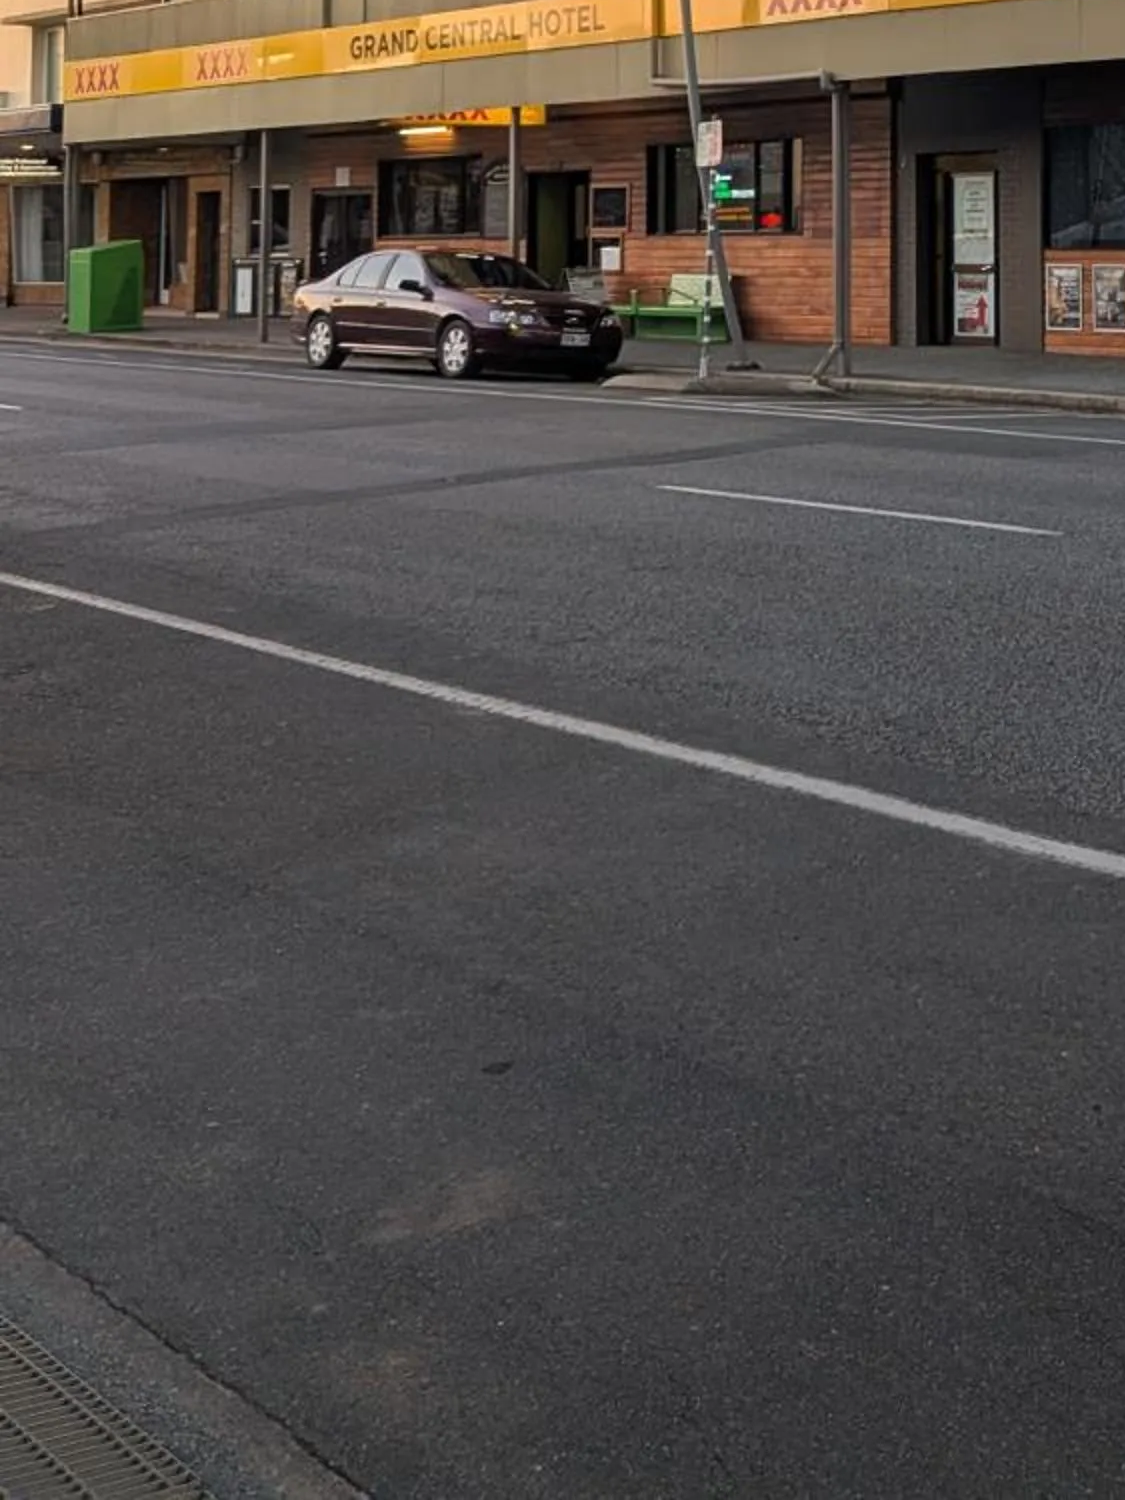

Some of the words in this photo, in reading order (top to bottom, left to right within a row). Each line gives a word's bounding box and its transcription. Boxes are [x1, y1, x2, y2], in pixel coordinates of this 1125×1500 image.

[351, 29, 418, 60] GRAND
[425, 15, 524, 50] CENTRAL
[529, 3, 606, 38] HOTEL
[75, 62, 120, 95] XXXX
[195, 46, 248, 82] XXXX
